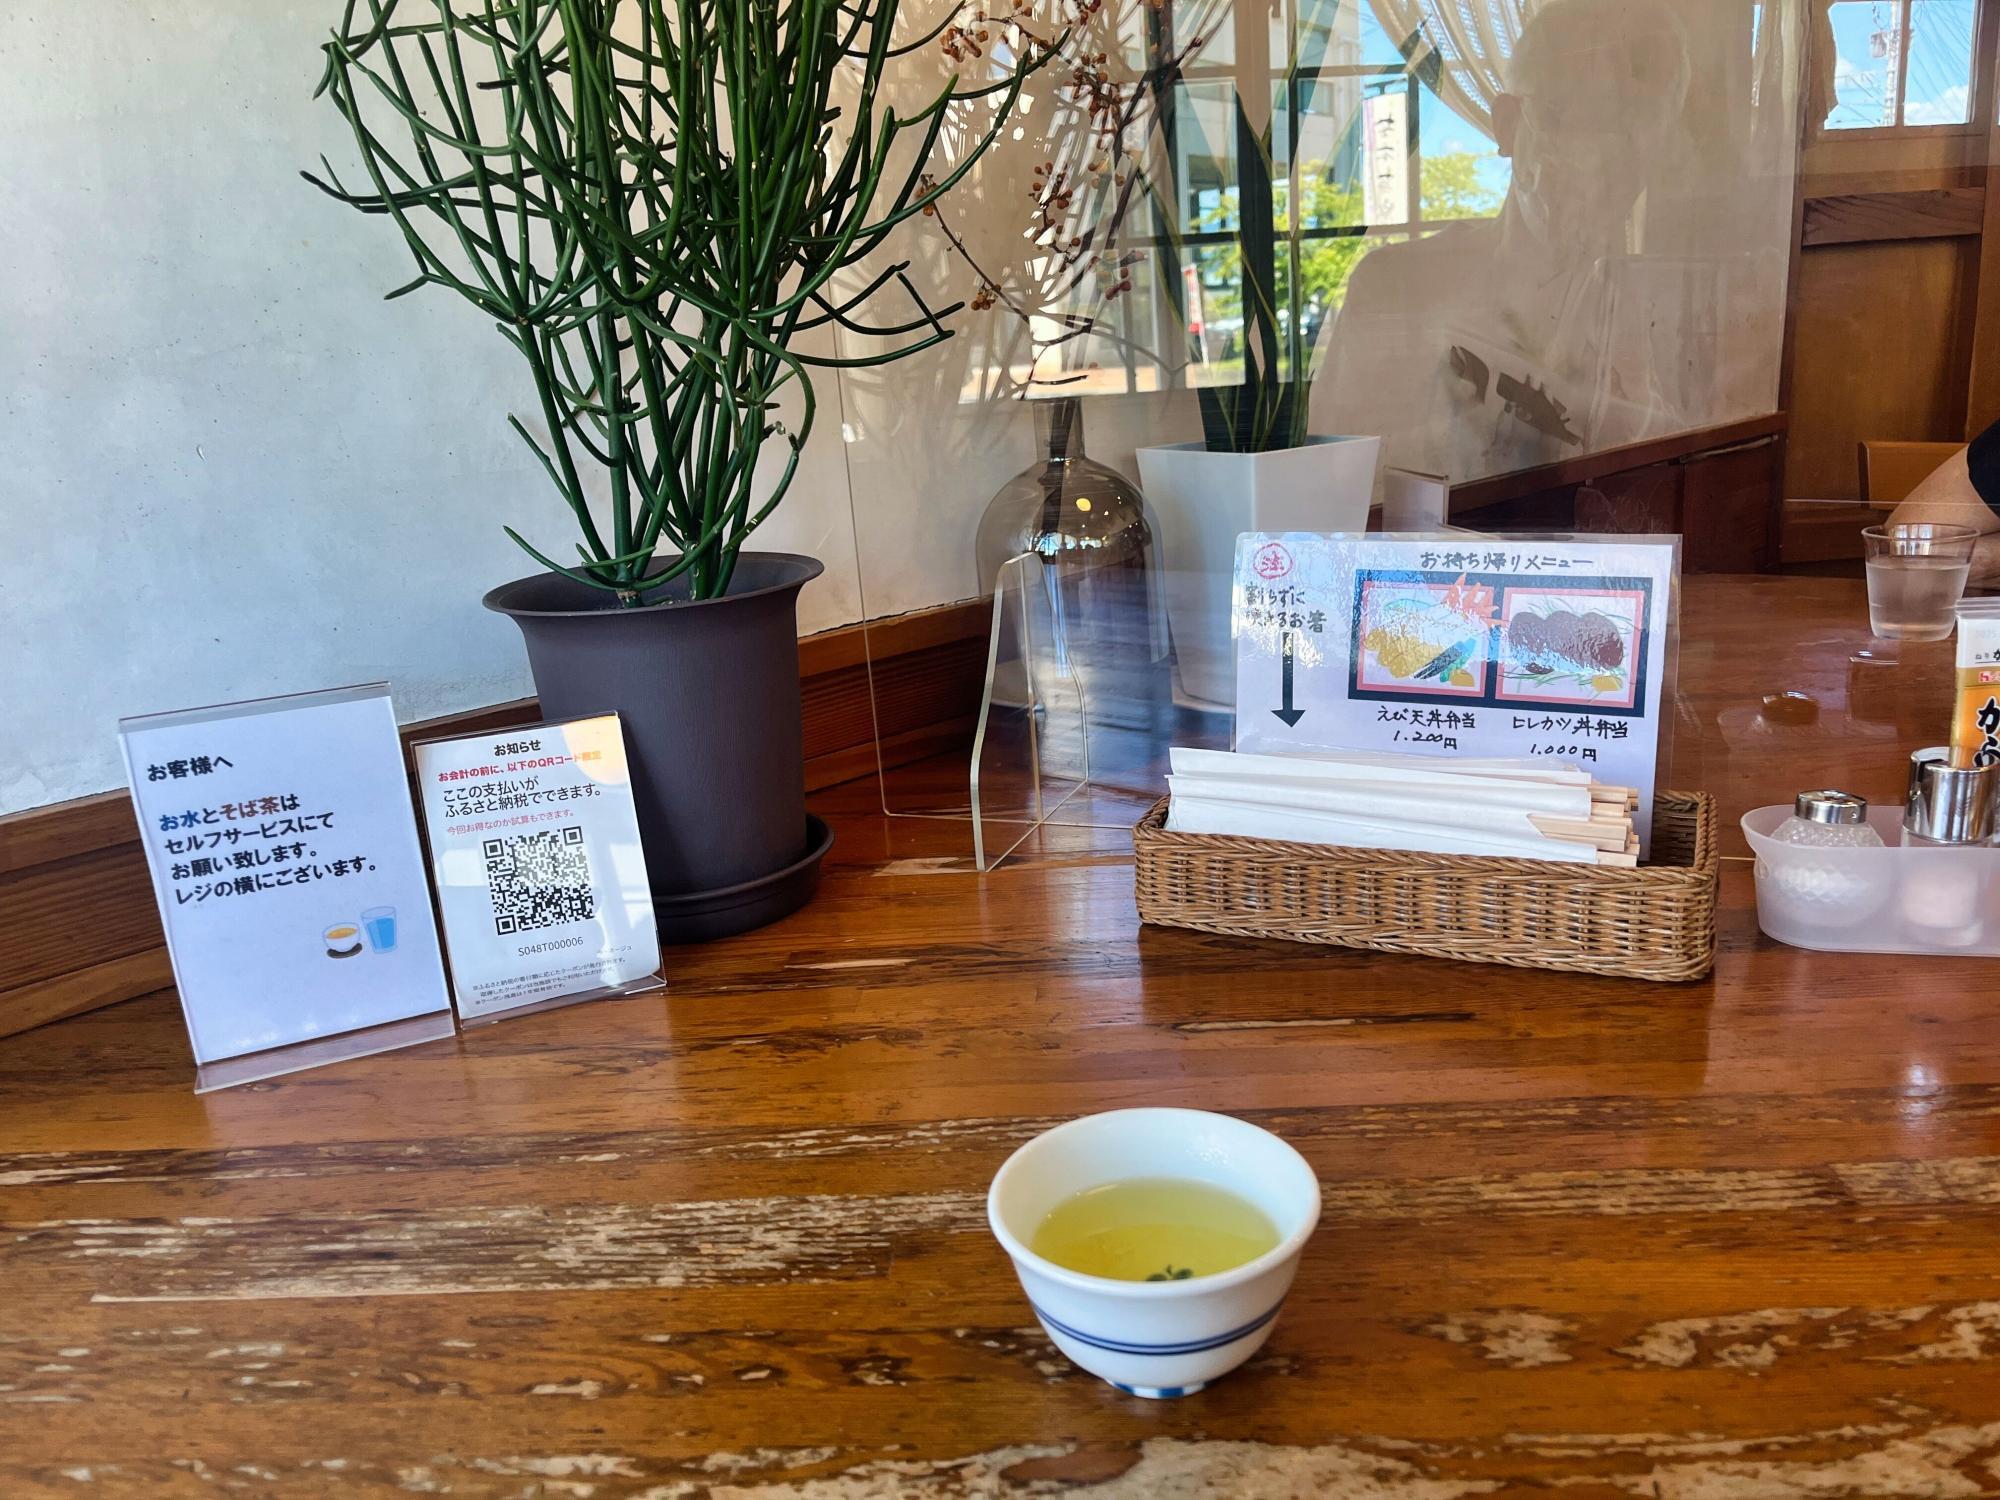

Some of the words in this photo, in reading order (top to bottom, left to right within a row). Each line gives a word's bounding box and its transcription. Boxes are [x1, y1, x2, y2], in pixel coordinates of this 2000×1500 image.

[1420, 551, 1594, 572] お持ち帰りメニュー
[494, 740, 541, 756] お知らせ
[147, 755, 233, 782] お客様へ
[444, 776, 539, 802] ここの支払いが
[445, 784, 601, 818] ふるさと納税でできます。
[159, 794, 300, 832] お水とそば茶は
[165, 811, 334, 855] セルフサービスにて
[171, 841, 317, 881] お願い致します。
[175, 856, 376, 905] レジの横にございます。
[518, 936, 584, 957] S048T000006
